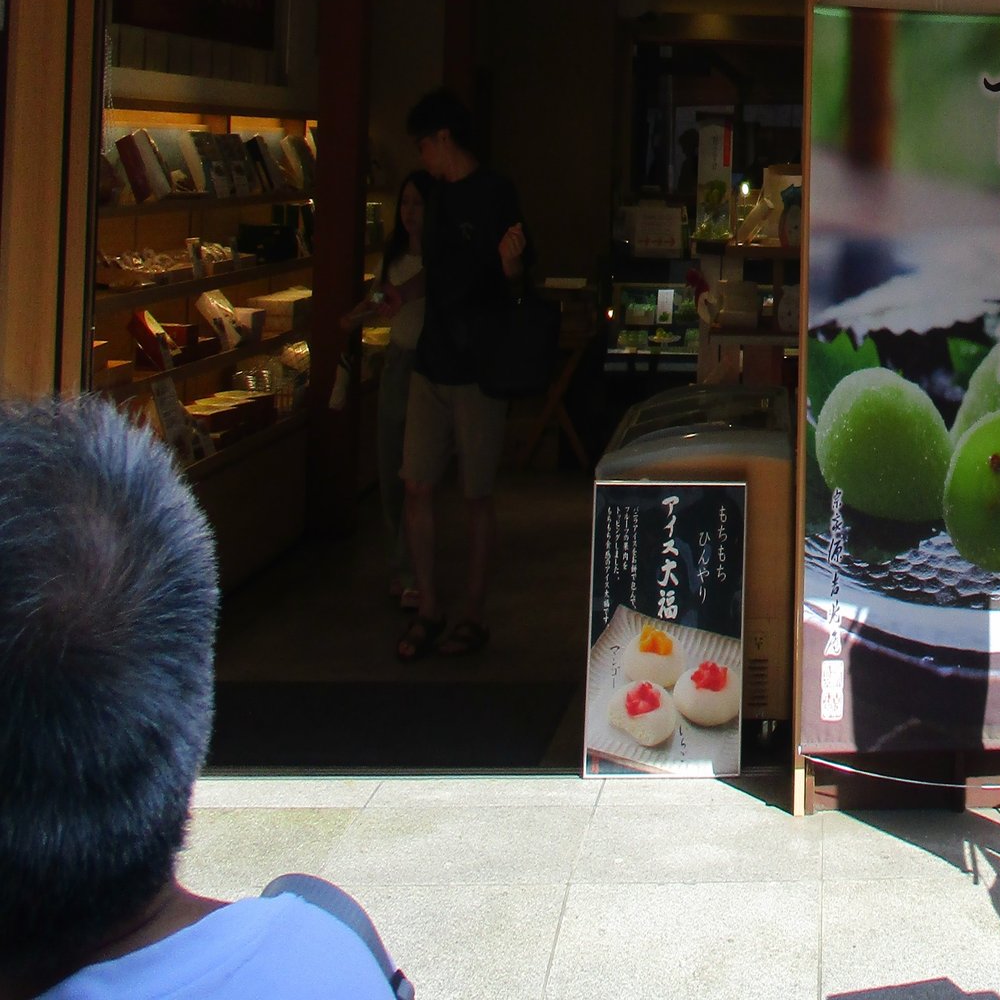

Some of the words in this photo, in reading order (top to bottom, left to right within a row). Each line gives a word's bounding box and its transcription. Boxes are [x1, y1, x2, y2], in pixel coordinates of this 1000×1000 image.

[656, 495, 680, 620] アイス大福
[697, 531, 710, 605] ひんやり
[716, 505, 728, 582] もちもち
